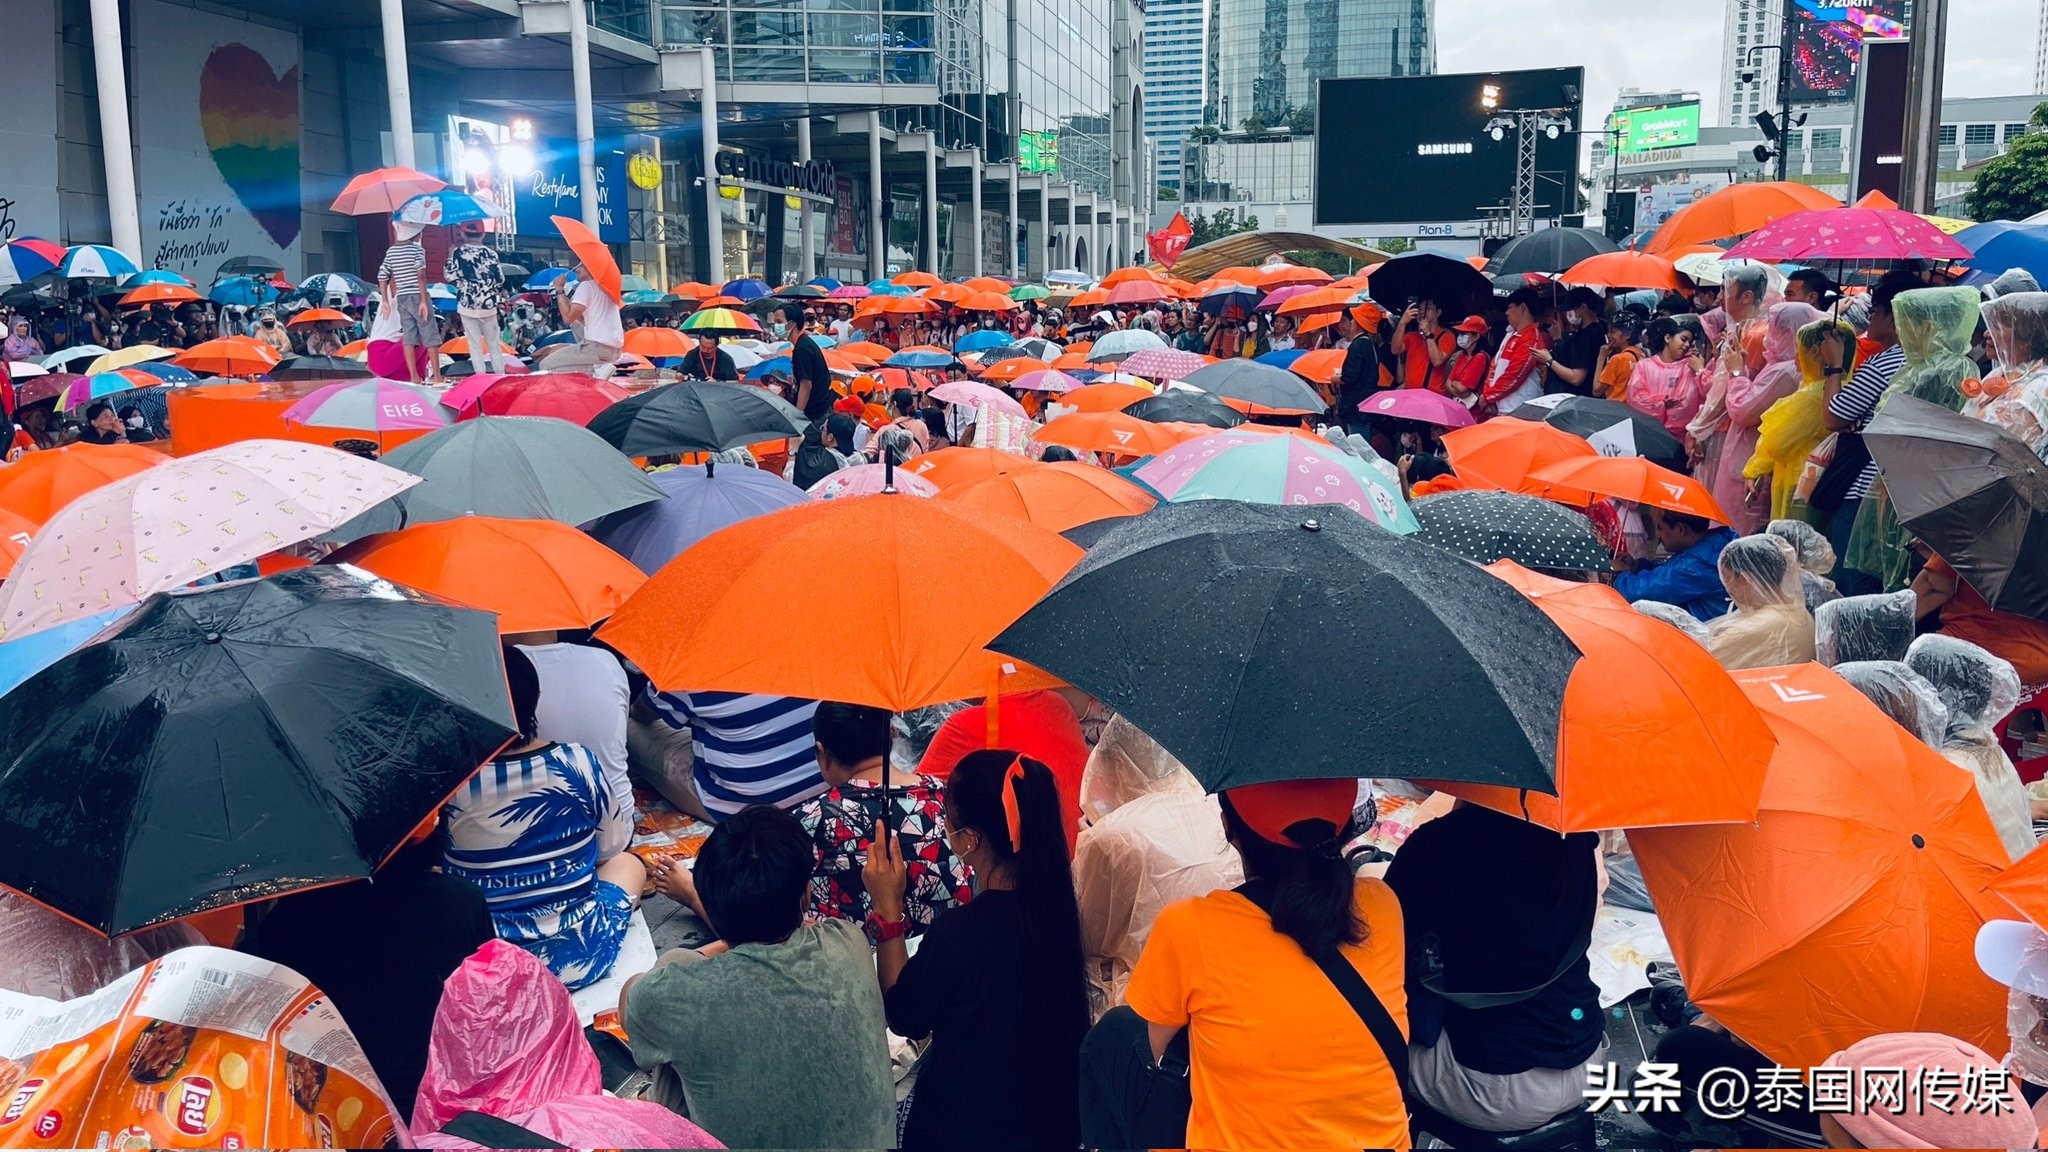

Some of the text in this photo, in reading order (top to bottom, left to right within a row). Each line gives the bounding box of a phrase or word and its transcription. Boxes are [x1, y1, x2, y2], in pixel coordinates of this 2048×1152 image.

[1642, 118, 1688, 131] GrabMart
[1418, 143, 1472, 155] SAMSUNG
[1620, 149, 1682, 165] PALLADIUM
[529, 170, 579, 208] Restylane
